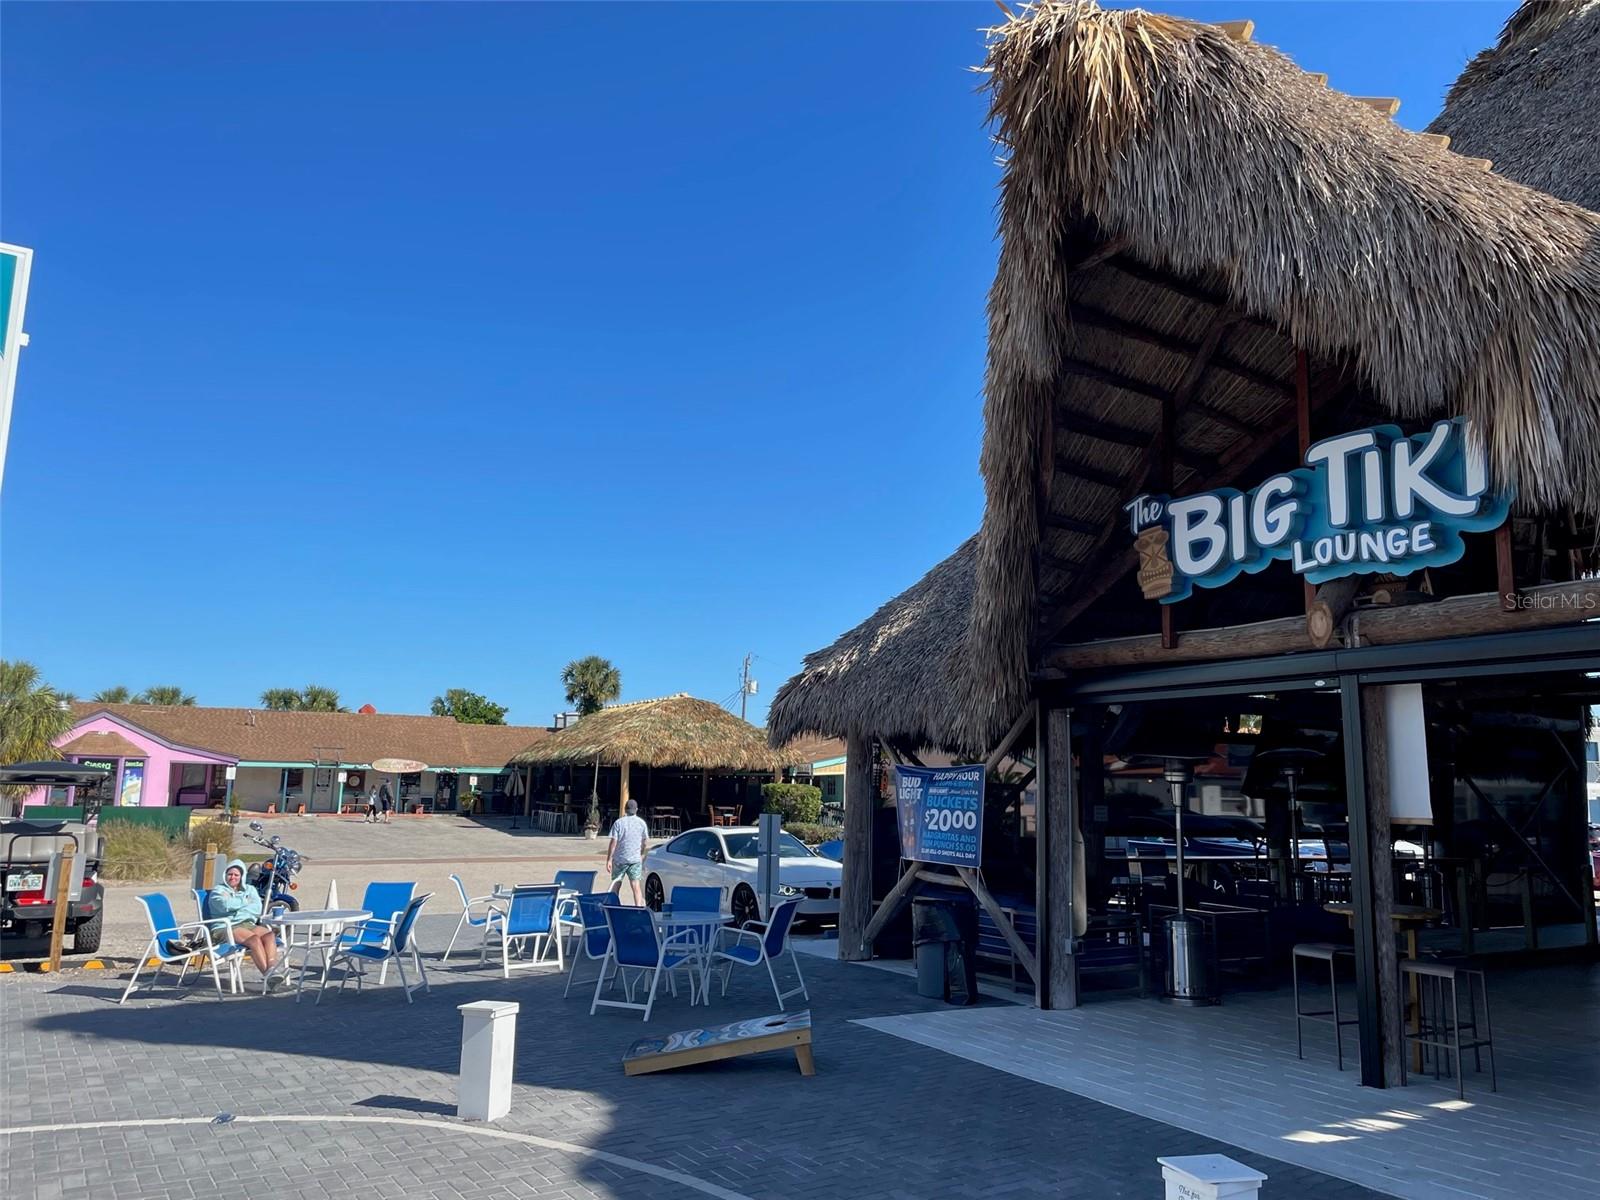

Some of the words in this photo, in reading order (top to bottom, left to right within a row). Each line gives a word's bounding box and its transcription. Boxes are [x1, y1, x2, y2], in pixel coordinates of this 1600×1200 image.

[1124, 494, 1163, 535] The
[1168, 475, 1298, 576] BIG
[1307, 419, 1487, 527] TIKI
[1294, 522, 1435, 573] LOUNGE
[902, 776, 921, 788] BUD
[933, 772, 957, 781] HAPPY
[956, 771, 980, 781] HOUR
[900, 788, 923, 800] LIGHT
[926, 796, 978, 810] BUCKETS
[960, 834, 976, 843] AND
